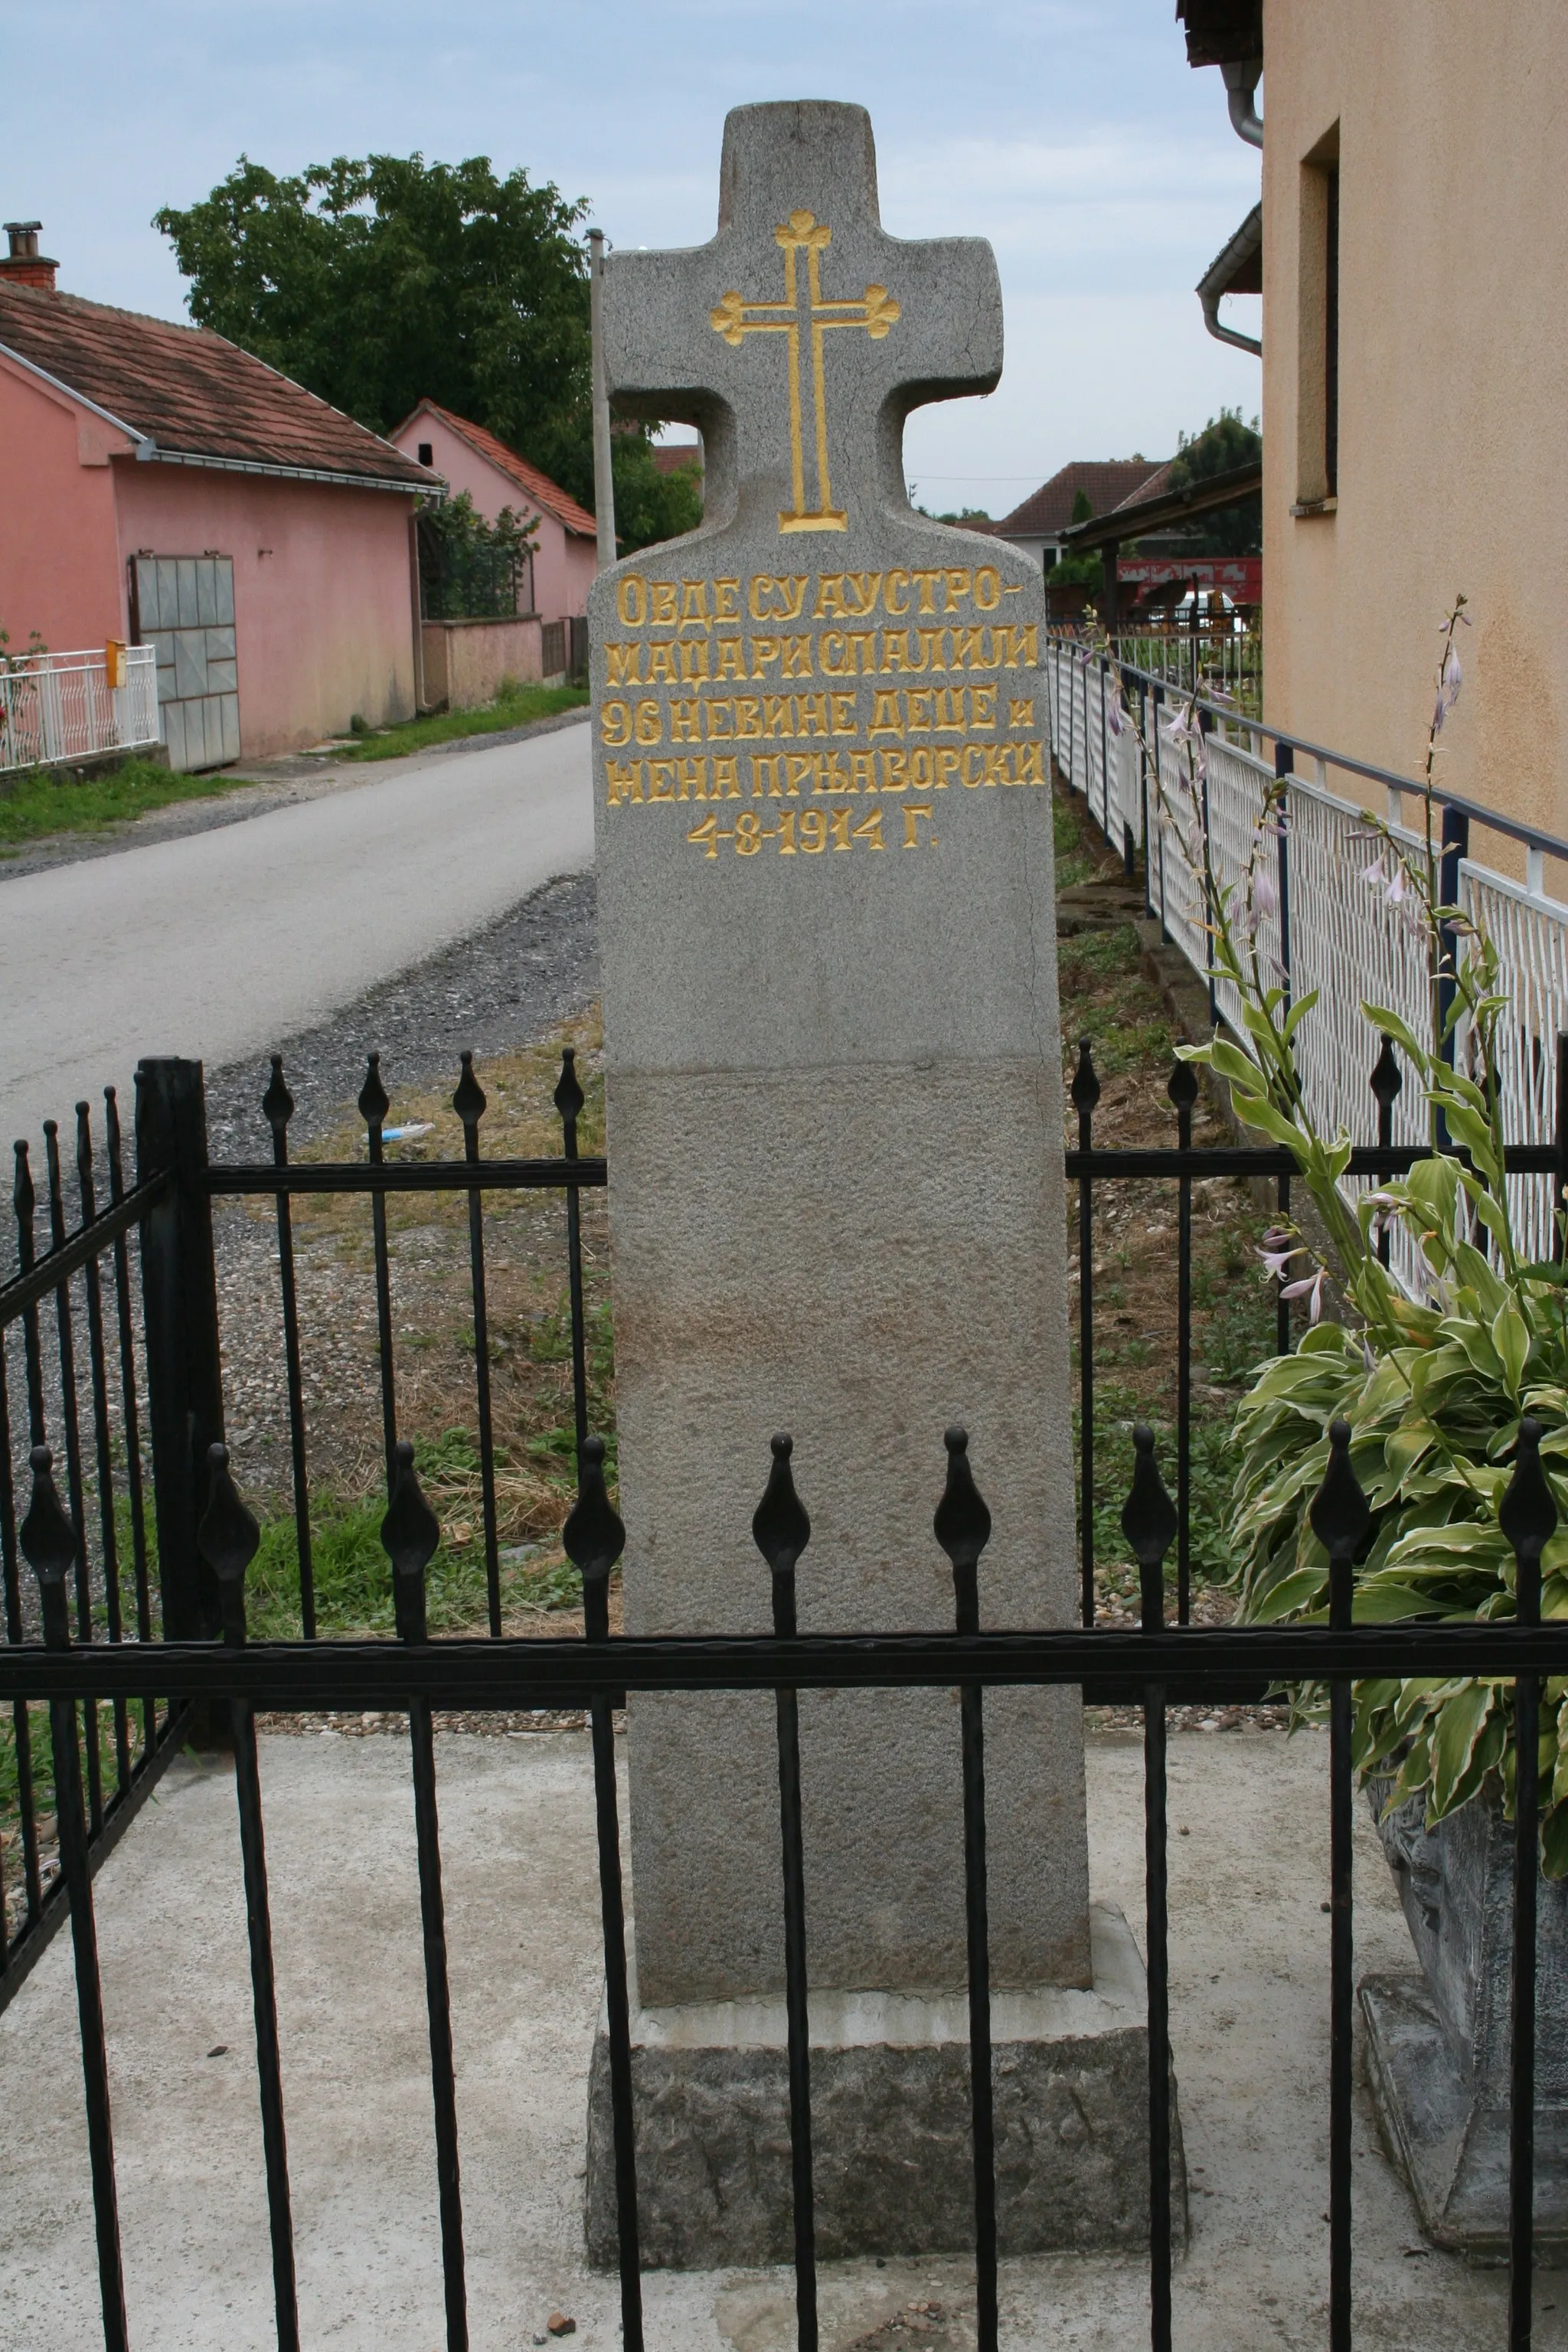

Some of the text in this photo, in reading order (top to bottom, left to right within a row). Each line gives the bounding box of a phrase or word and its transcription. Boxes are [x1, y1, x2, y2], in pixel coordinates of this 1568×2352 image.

[617, 566, 1024, 633] ОВДЕ СУ АУСТРО-
[817, 624, 1039, 678] СПАЛИЛИ
[600, 697, 663, 746] 96
[668, 691, 858, 743] НЕВИНЕ
[867, 683, 997, 740] ДЕЦЕ
[749, 740, 1046, 797] ПРЊАВОРСКИ
[688, 805, 885, 860] 4-8-1914
